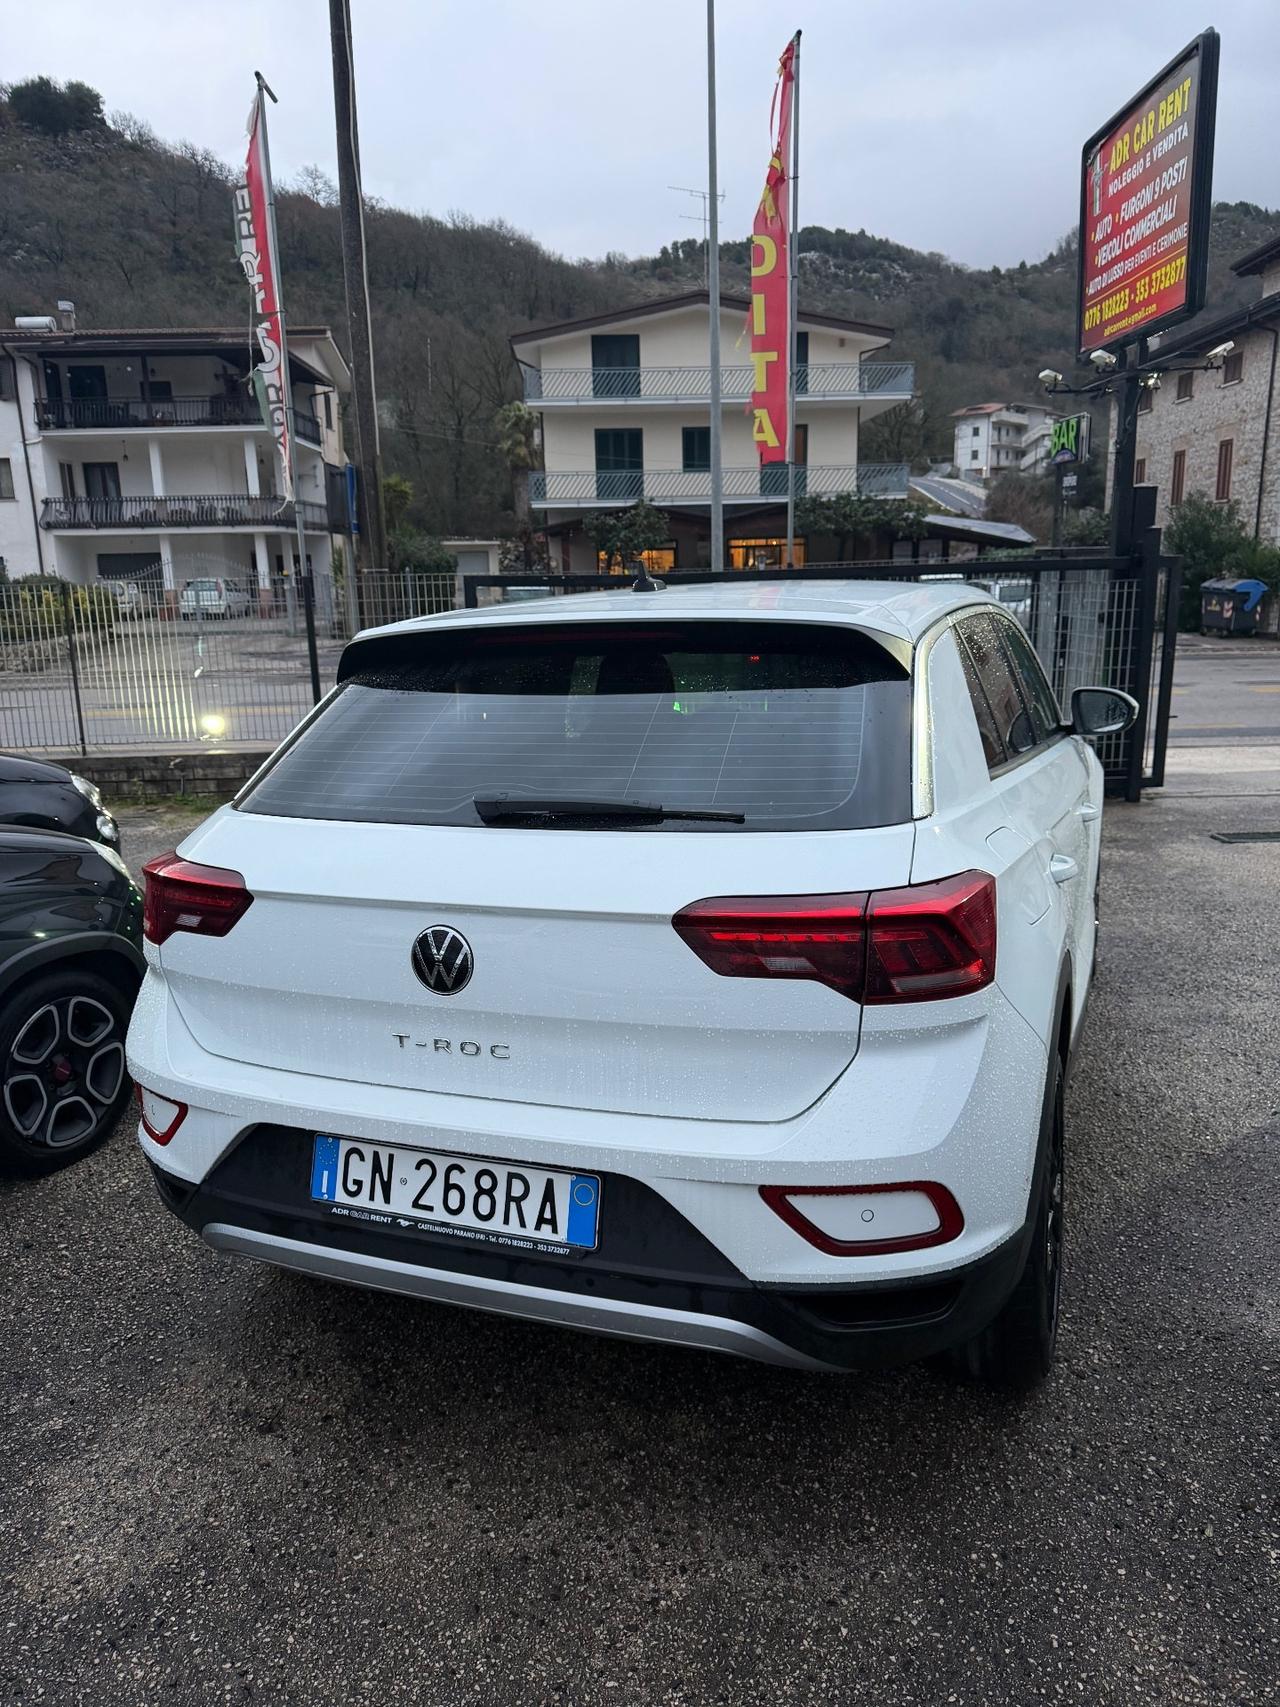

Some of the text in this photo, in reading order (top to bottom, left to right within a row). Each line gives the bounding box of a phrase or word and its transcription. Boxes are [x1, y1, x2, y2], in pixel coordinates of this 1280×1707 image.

[1108, 121, 1188, 198] NOLEGGIO E VENDITA
[1109, 76, 1192, 175] ADR CAR RENT
[1094, 155, 1188, 244] AUTO FURGONI 9 POSTI
[1097, 194, 1177, 268] VEICOLI COMMERCIALI
[1152, 241, 1157, 256] E
[1084, 303, 1100, 331] 0776
[1135, 275, 1149, 304] 353
[1150, 255, 1187, 295] 3732877
[1051, 418, 1078, 458] BAR
[392, 1032, 511, 1060] T-ROC
[331, 1206, 350, 1216] ADR
[370, 1214, 393, 1224] RENT
[417, 1222, 454, 1235] CASTELNUOVO
[453, 1229, 475, 1239] PARANO
[489, 1235, 498, 1243] Tel.
[498, 1237, 511, 1246] 0776
[341, 1146, 395, 1206] GN
[411, 1158, 559, 1235] 268RA
